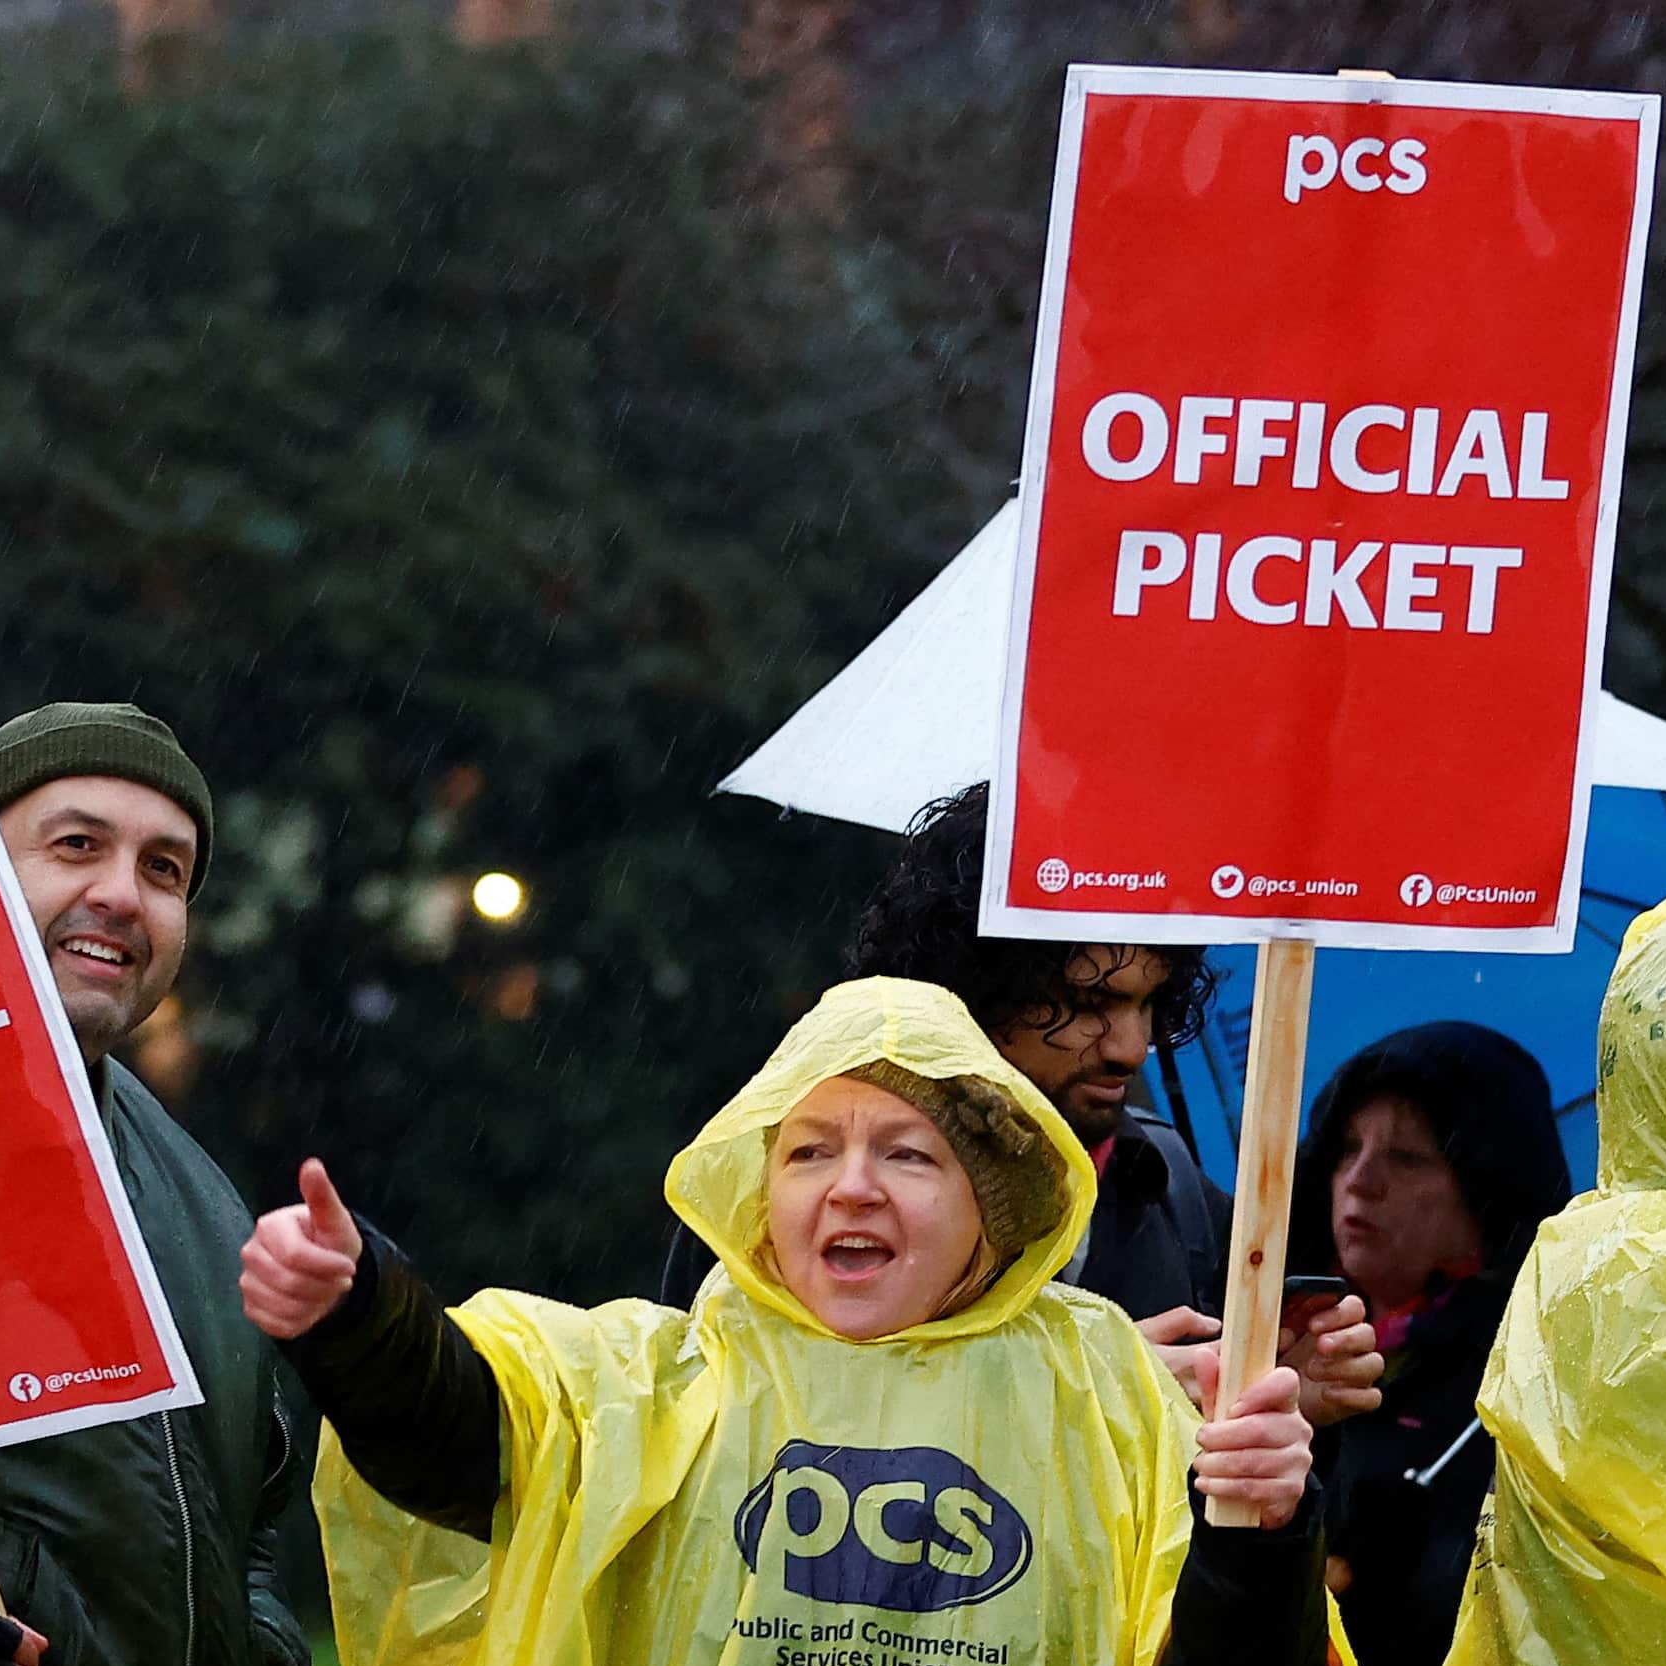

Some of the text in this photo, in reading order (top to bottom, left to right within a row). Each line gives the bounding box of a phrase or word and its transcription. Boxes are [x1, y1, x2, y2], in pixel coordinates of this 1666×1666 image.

[1283, 133, 1427, 204] pcs
[1081, 392, 1569, 500] OFFICIAL
[1112, 530, 1523, 634] PICKET
[1072, 869, 1537, 905] pcs.org.uk @pcs_union @PcsUnion
[44, 1362, 142, 1394] @PcsUnion
[753, 1465, 995, 1596] pcs
[810, 1618, 854, 1643] and
[861, 1621, 1009, 1666] Commercial
